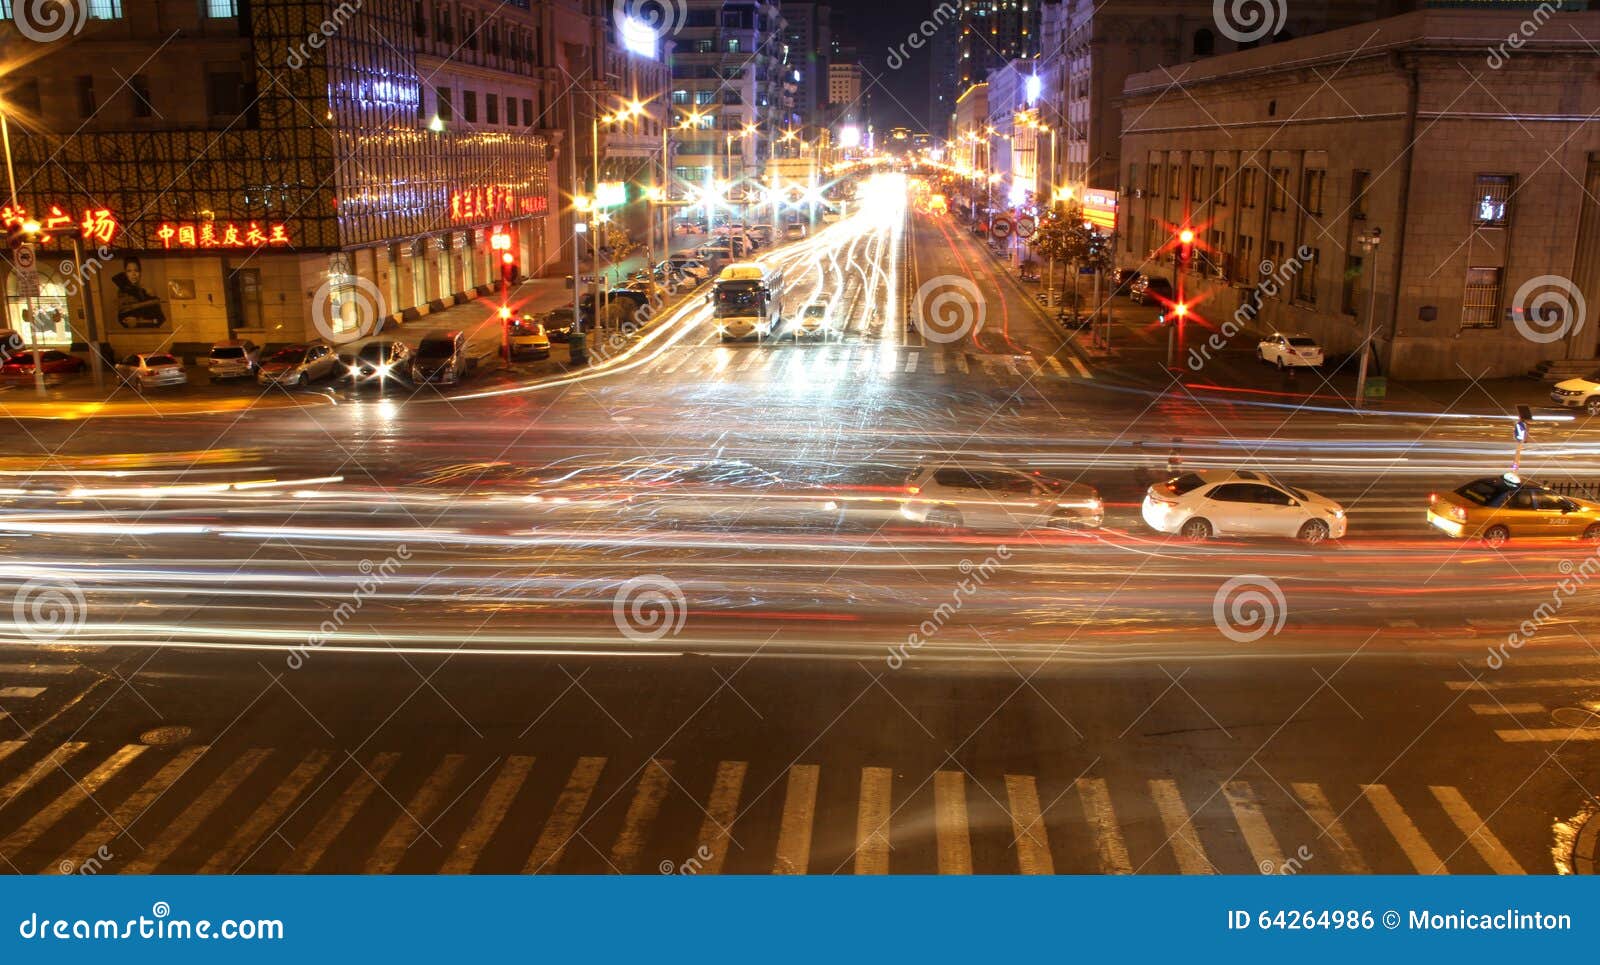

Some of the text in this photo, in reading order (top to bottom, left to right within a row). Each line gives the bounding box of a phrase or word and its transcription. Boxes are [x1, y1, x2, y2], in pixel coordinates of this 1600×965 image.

[158, 223, 289, 249] 中国裘皮衣王
